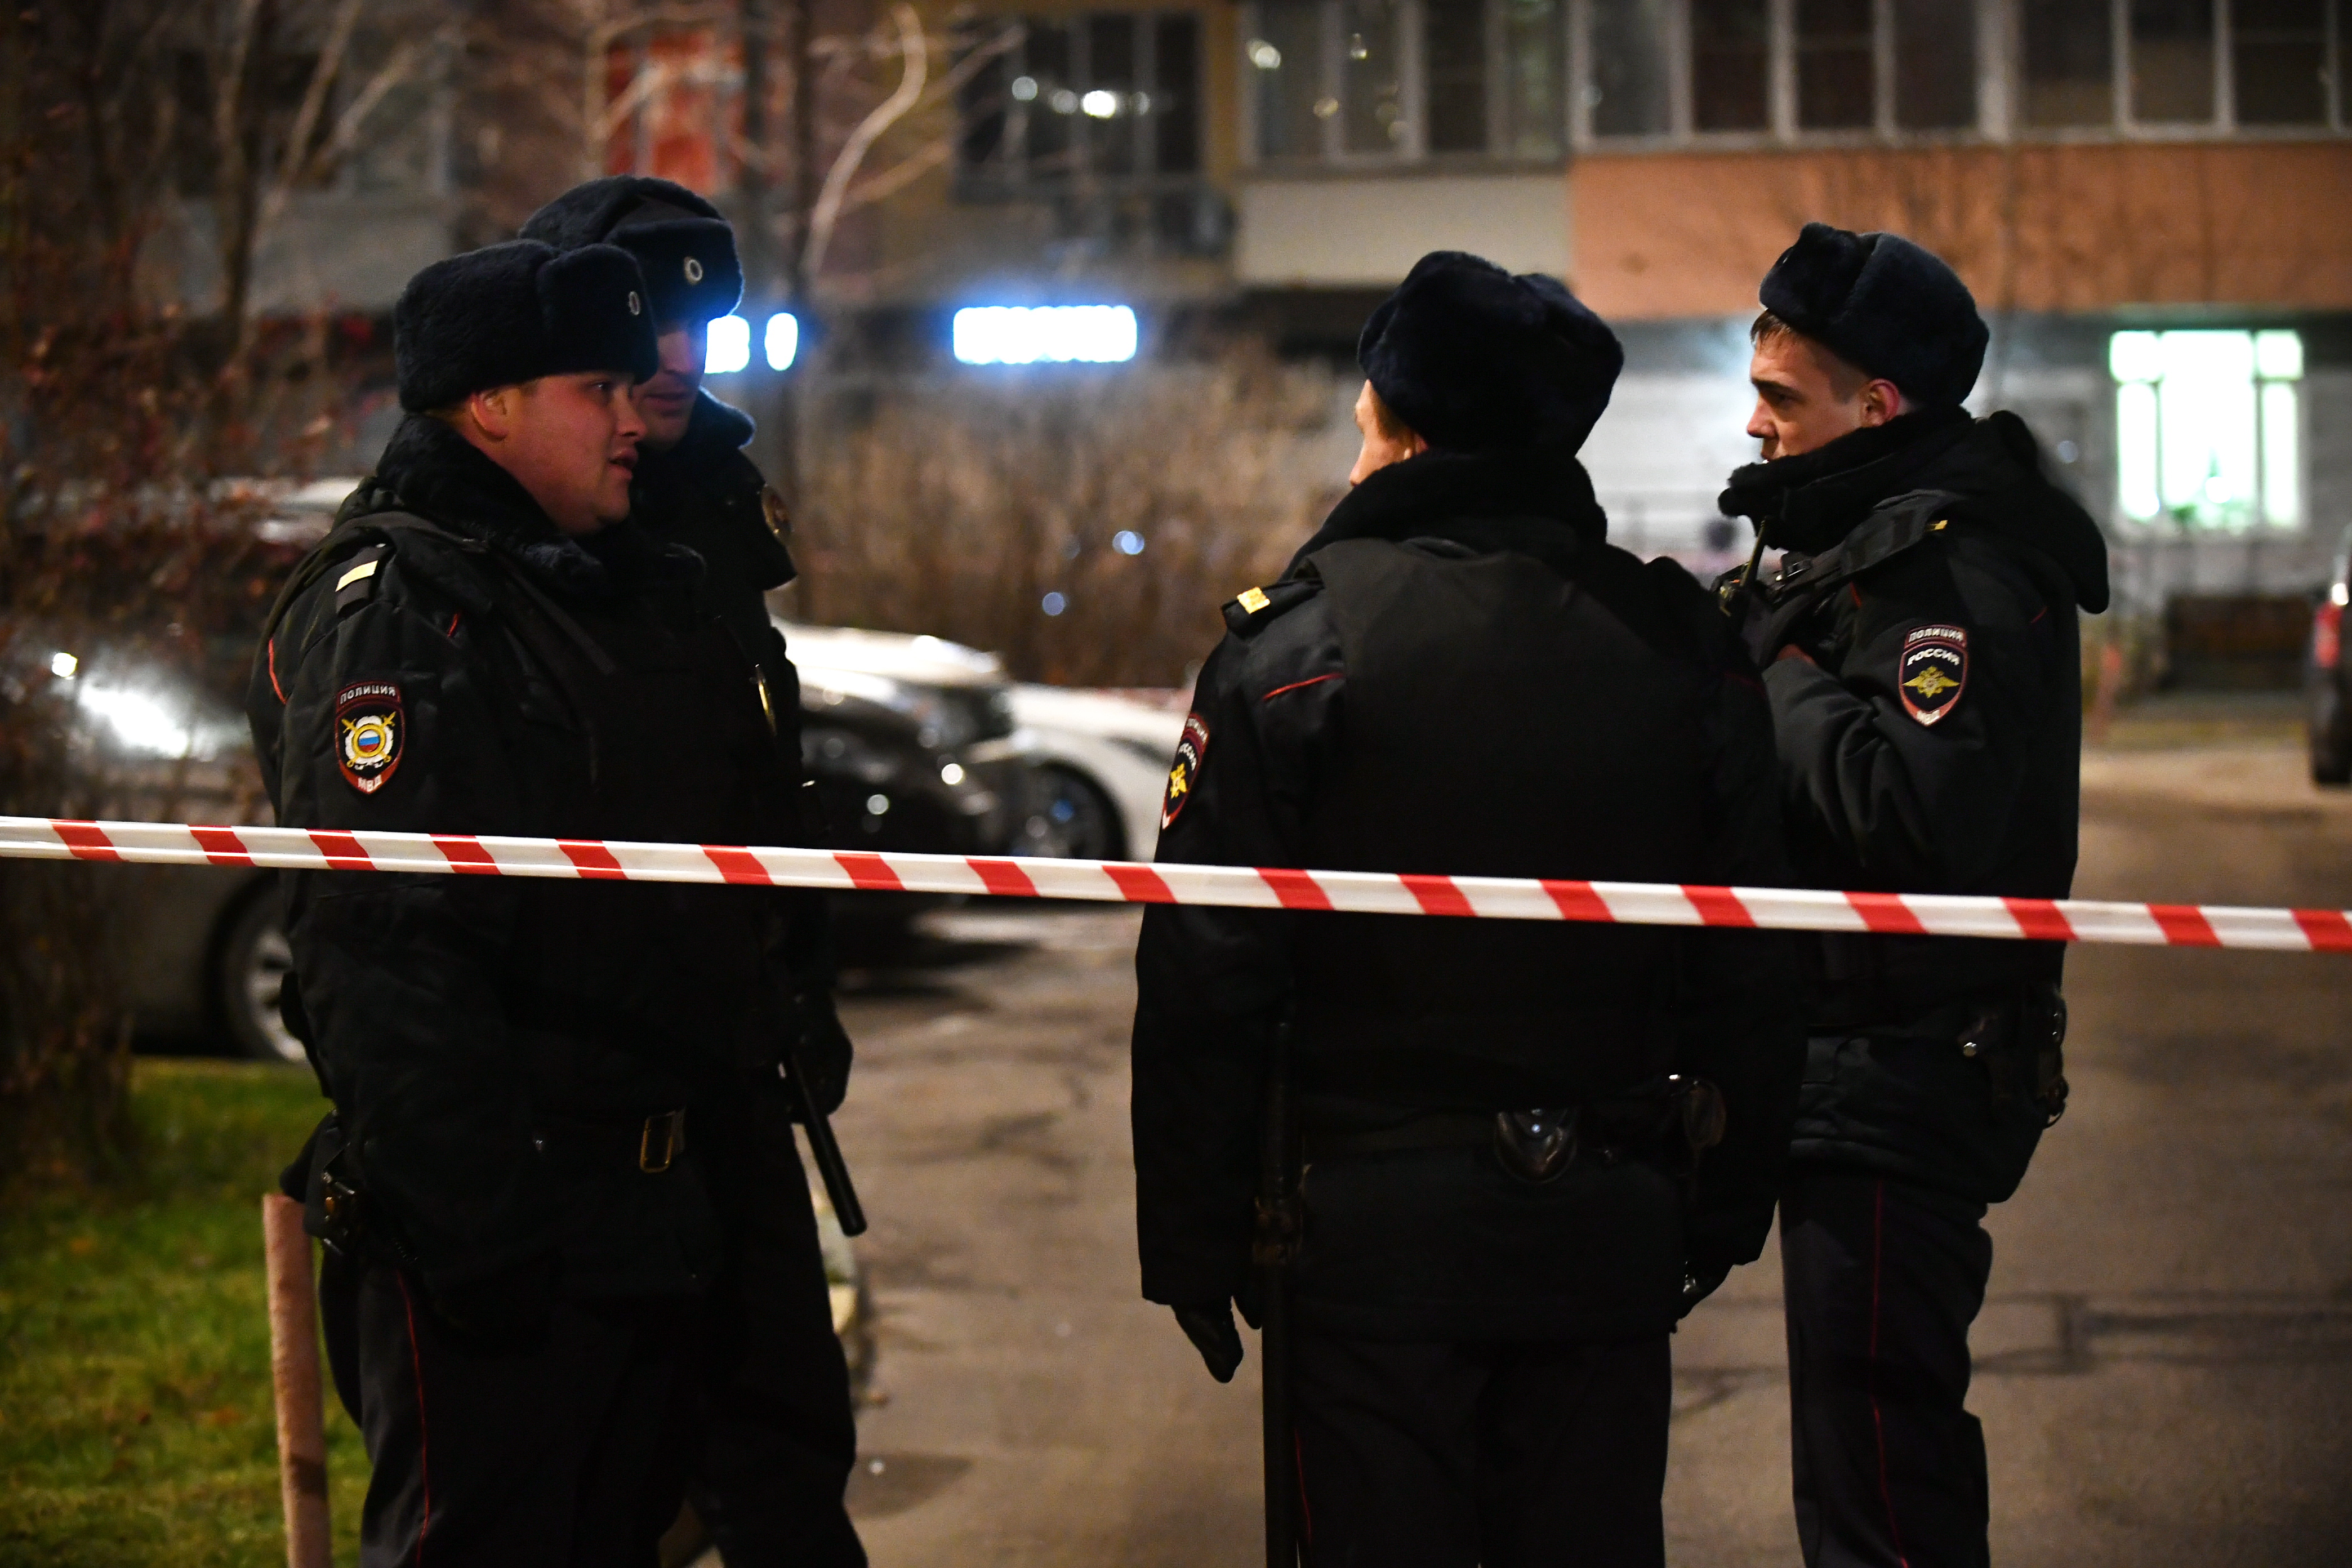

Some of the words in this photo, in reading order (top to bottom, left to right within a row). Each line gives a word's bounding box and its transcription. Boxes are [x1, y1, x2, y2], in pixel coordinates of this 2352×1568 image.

[1908, 627, 1963, 642] ПОЛИЦИЯ
[1907, 648, 1960, 666] РОССИЯ
[340, 685, 396, 704] ПОЛИЦИЯ
[358, 774, 382, 792] МВД
